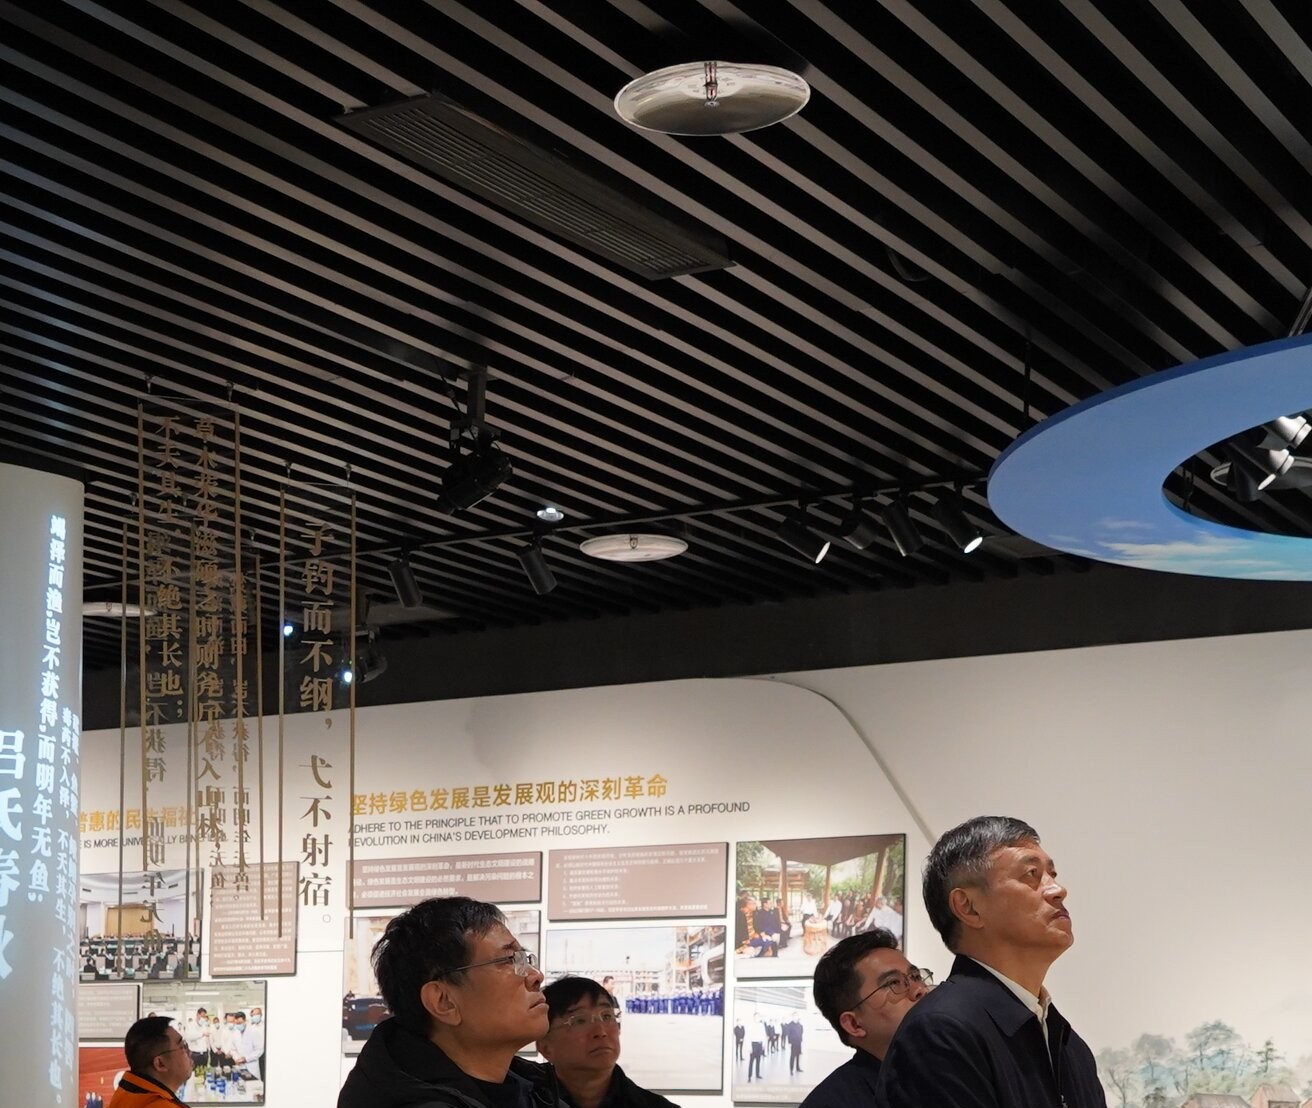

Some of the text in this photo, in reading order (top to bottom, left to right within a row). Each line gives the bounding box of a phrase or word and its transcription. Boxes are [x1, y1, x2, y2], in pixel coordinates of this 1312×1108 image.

[351, 773, 668, 816] 坚持绿色发展是发展观的深刻革命
[389, 821, 402, 832] TO
[404, 820, 422, 831] THE
[425, 816, 476, 829] PRINCIPLE
[478, 814, 504, 826] THAT
[506, 813, 519, 824] TO
[522, 810, 572, 823] PROMOTE
[575, 809, 611, 821] GREEN
[614, 805, 662, 819] GROWTH
[665, 805, 675, 816] IS
[677, 804, 685, 815] A
[688, 801, 750, 814] PROFOUND
[94, 838, 119, 848] MORE
[410, 834, 419, 844] IN
[423, 831, 462, 844] CHINA'S
[464, 827, 538, 841] DEVELOPMENT
[541, 824, 610, 837] PHILOSOPHY.
